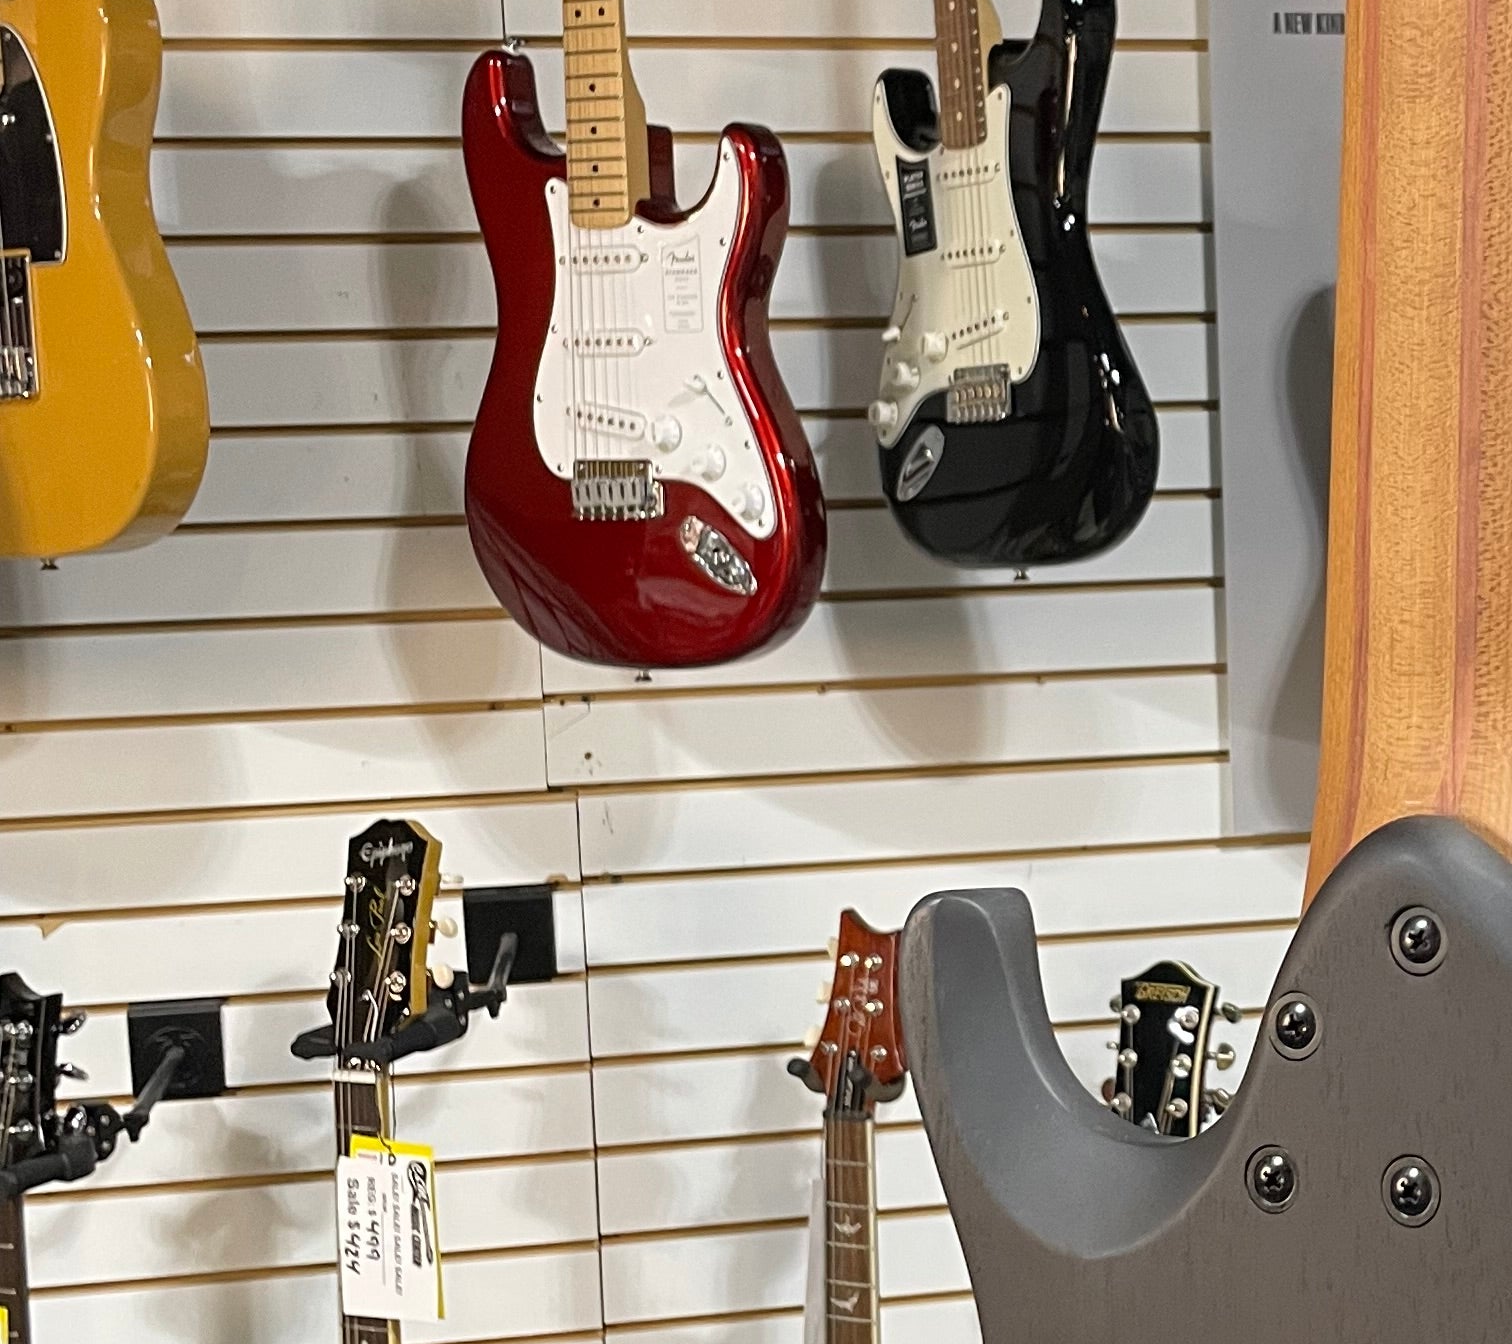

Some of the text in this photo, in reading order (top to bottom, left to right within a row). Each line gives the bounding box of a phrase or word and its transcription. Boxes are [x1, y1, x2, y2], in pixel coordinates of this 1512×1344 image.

[1284, 12, 1313, 35] NEW
[347, 1178, 359, 1216] Sale
[366, 1220, 381, 1261] 499
